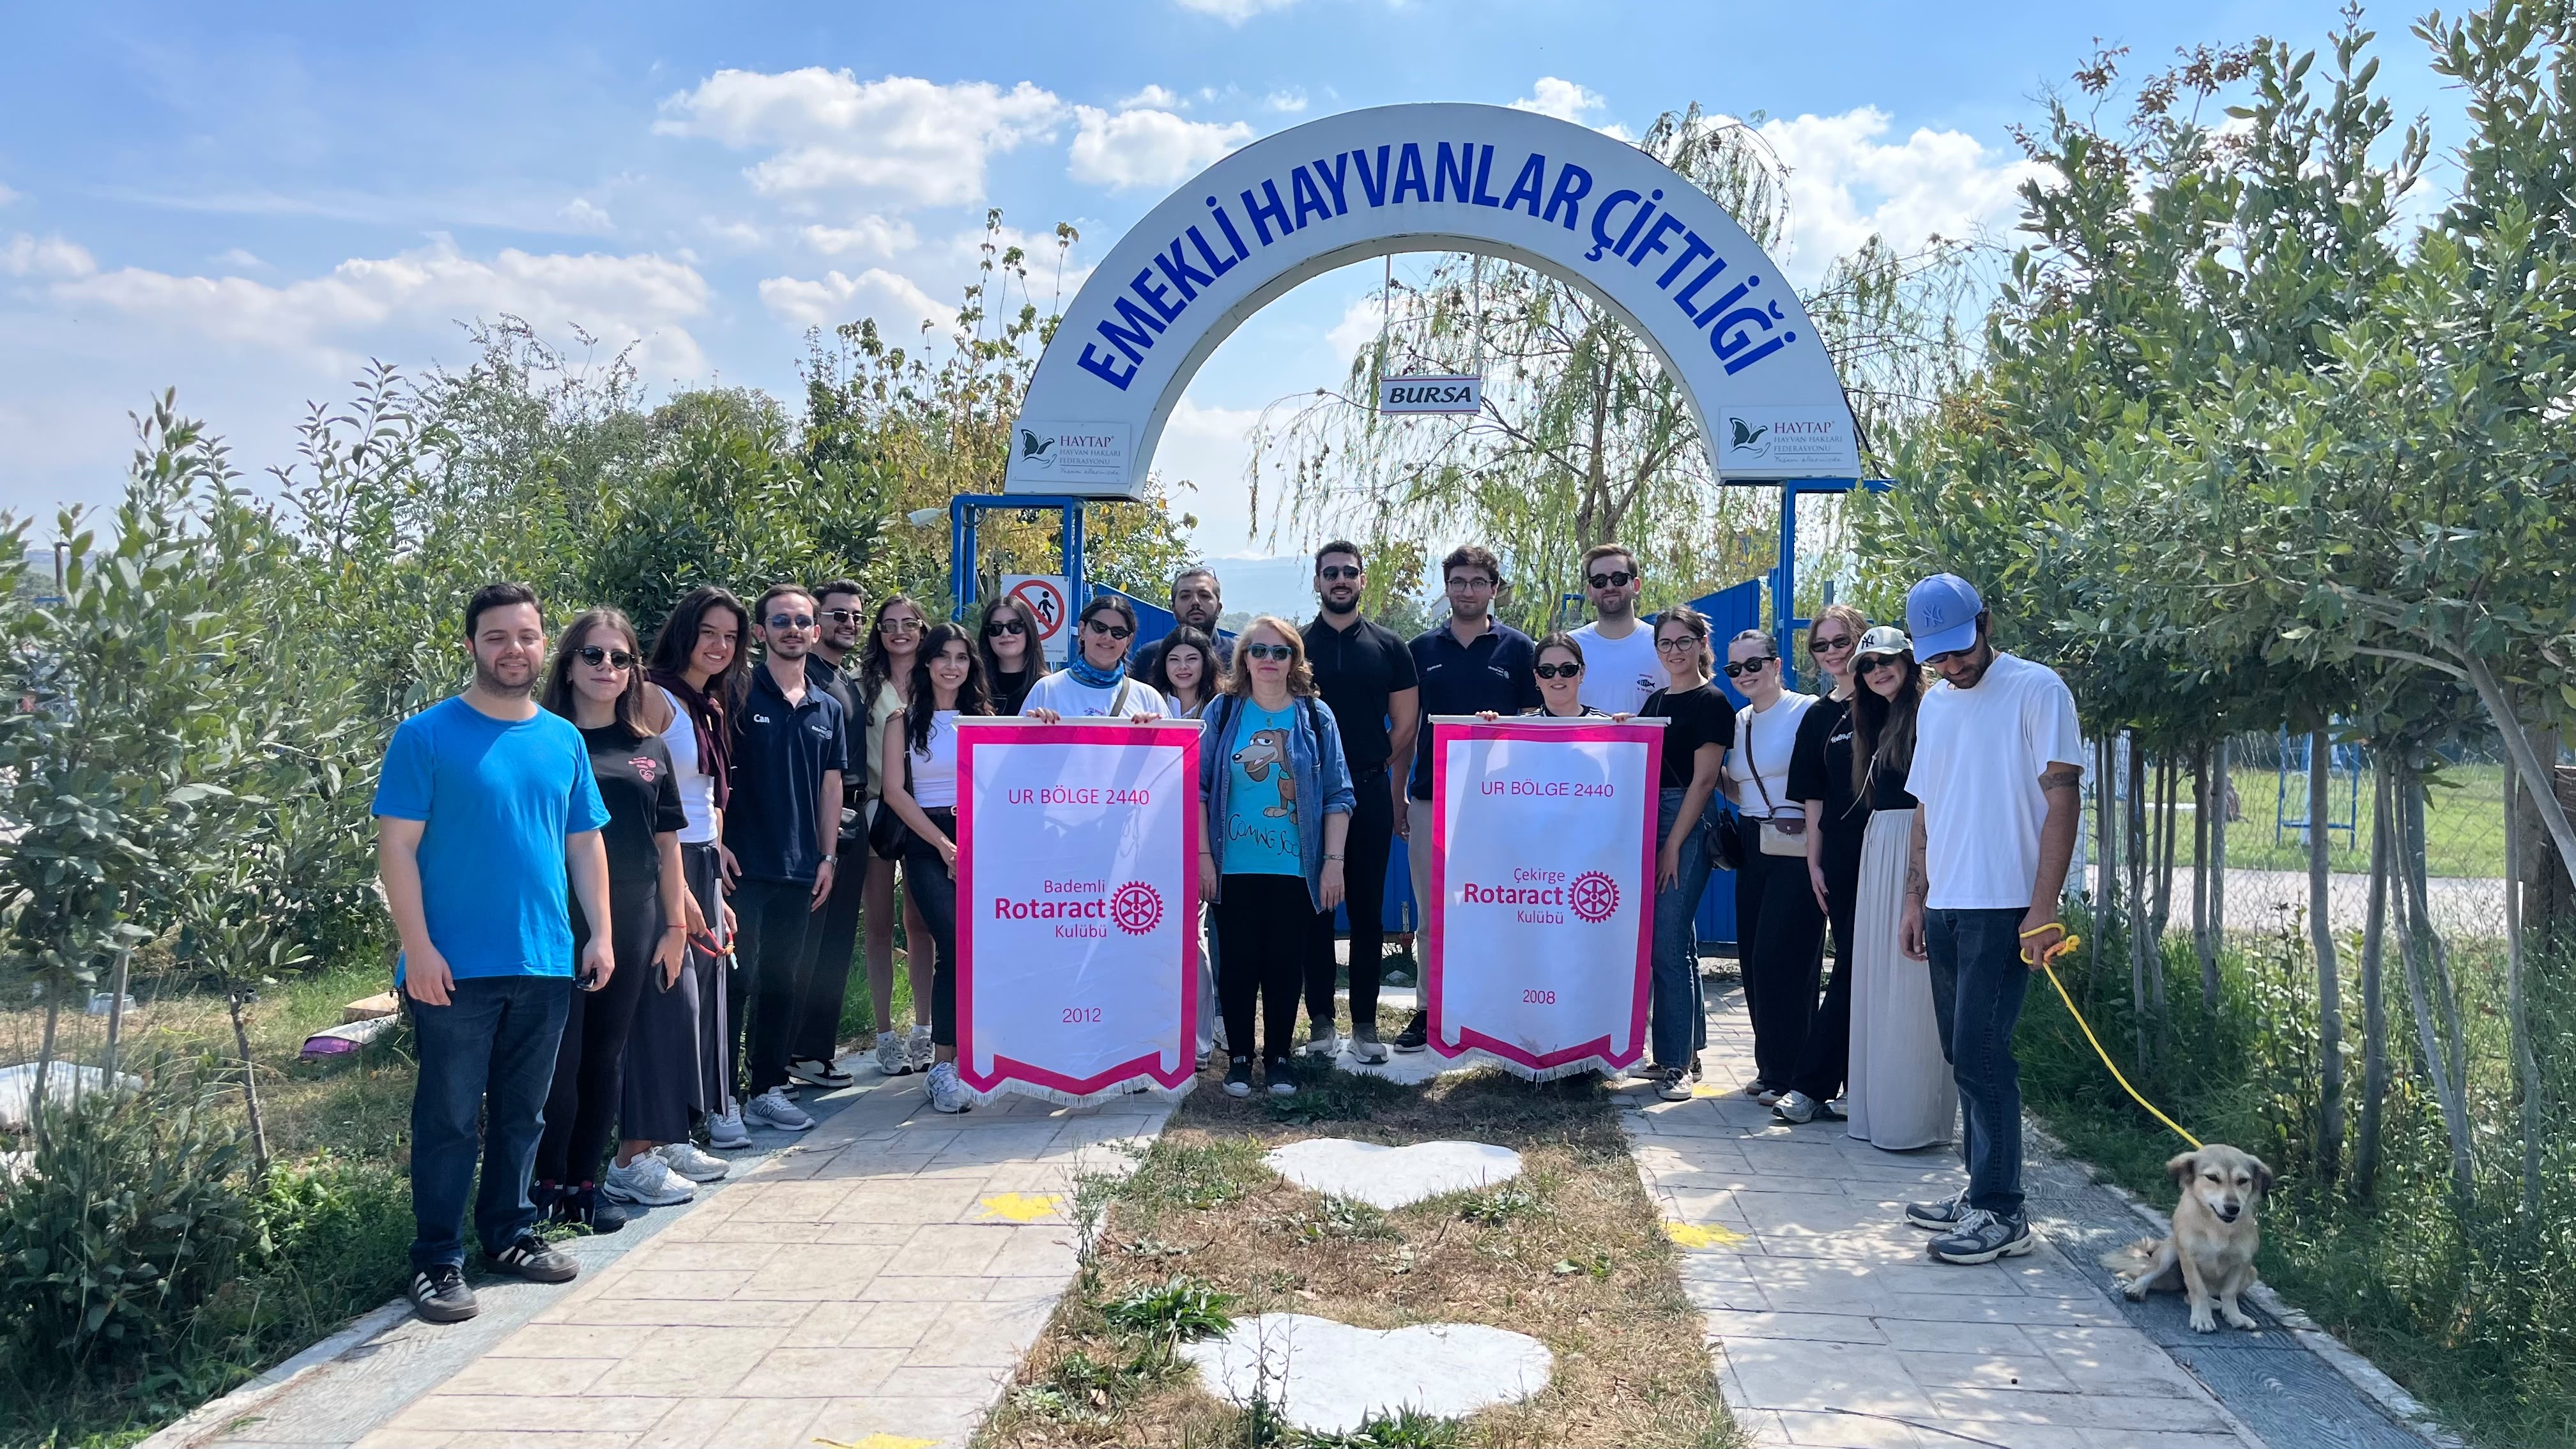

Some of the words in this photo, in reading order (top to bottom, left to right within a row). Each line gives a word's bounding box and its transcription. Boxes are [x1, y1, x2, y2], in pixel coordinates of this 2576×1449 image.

[1077, 195, 1251, 392] EMEKLİ
[1240, 141, 1593, 247] HAYVANLAR
[1584, 188, 1797, 376] ÇİFTLİĞİ
[1389, 387, 1472, 404] BURSA
[1774, 422, 1832, 434] HAYTAP
[1060, 435, 1112, 447] HAYTAP
[1861, 634, 1874, 650] NY
[753, 714, 770, 723] Can
[1008, 788, 1034, 804] UR
[1040, 785, 1100, 805] BÖLGE
[1105, 789, 1150, 806] 2440
[1482, 781, 1505, 795] UR
[1512, 778, 1569, 797] BÖLGE
[1574, 783, 1614, 798] 2440
[1278, 830, 1300, 857] SOO
[1514, 867, 1565, 884] Çekirge
[1043, 880, 1105, 894] Bademli
[1464, 883, 1563, 906] Rotaract
[995, 898, 1107, 920] Rotaract
[1517, 910, 1564, 924] Kulübü
[1055, 924, 1107, 939] Kulübü
[1522, 989, 1556, 1005] 2008
[1062, 1008, 1101, 1023] 2012
